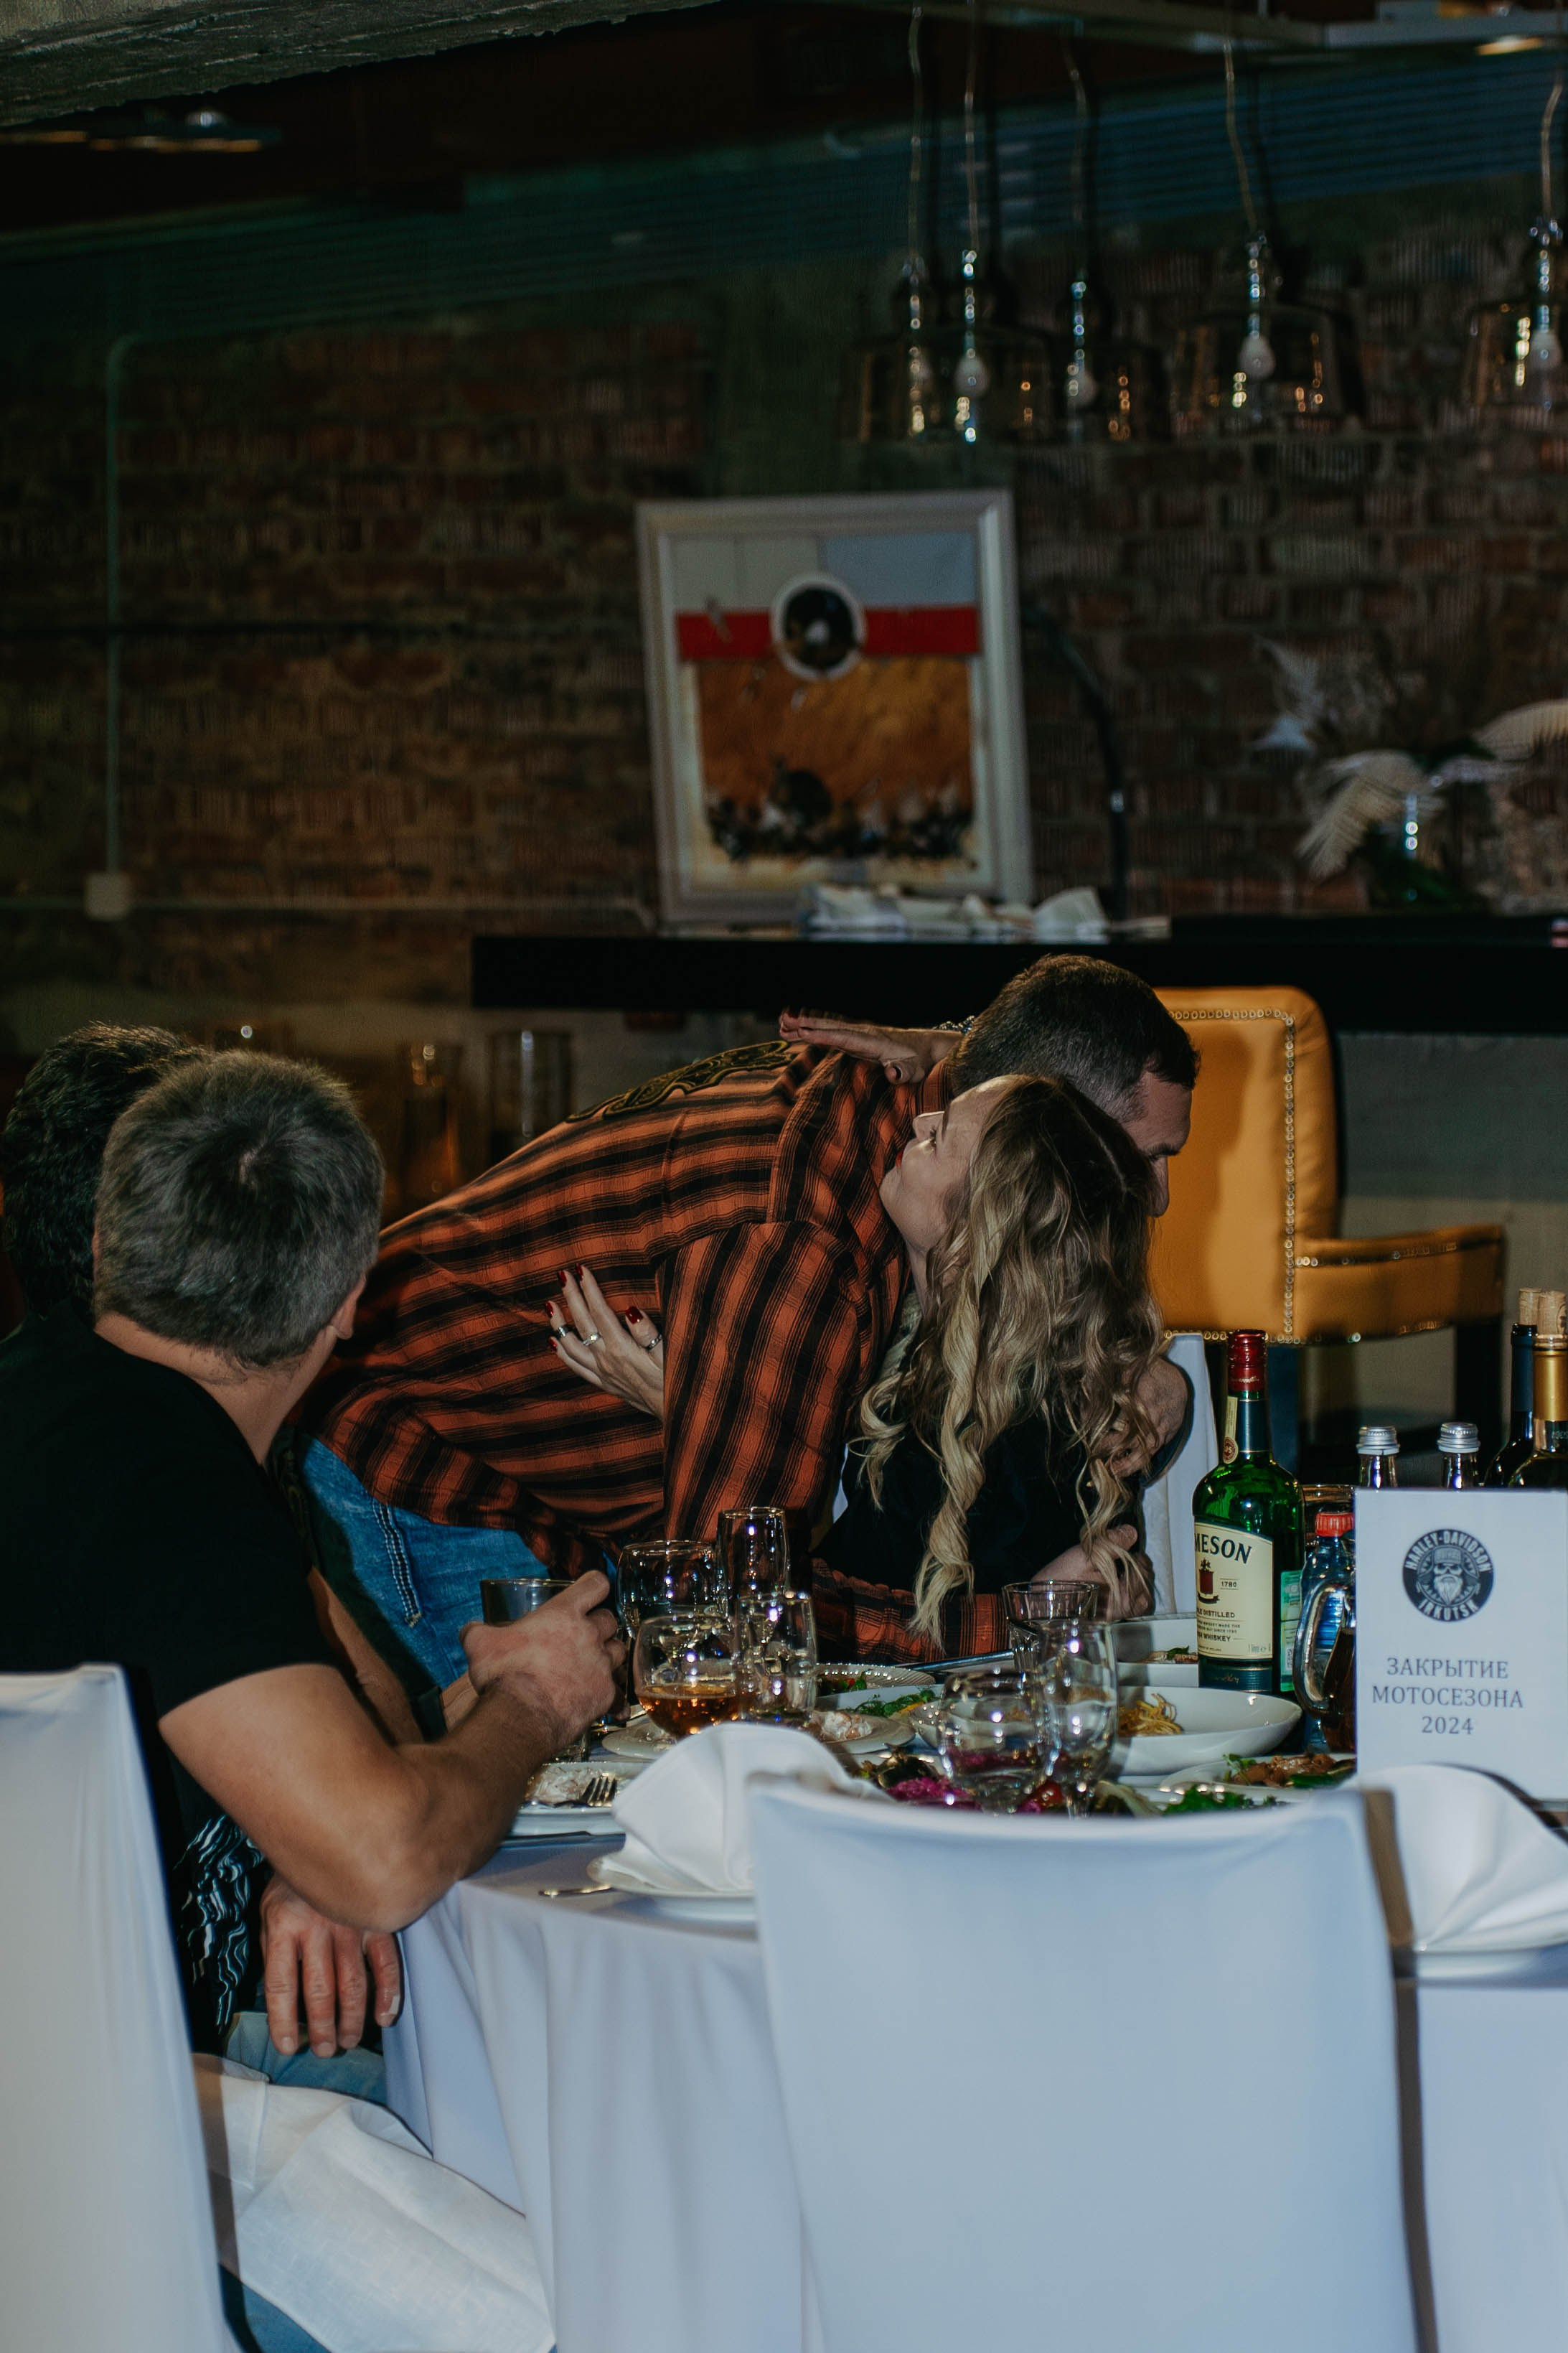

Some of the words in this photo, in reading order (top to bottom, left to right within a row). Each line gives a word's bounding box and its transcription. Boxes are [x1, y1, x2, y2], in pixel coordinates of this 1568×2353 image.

[1404, 1530, 1491, 1572] HARLEY-DAVIDSON
[1203, 1609, 1236, 1618] DISTILLED
[1418, 1599, 1478, 1621] IRKUTSK
[1203, 1633, 1231, 1642] WHISKEY
[1386, 1657, 1508, 1679] ЗАКРЫТИЕ
[1371, 1685, 1524, 1708] МОТОСЕЗОНА
[1422, 1716, 1474, 1735] 2024
